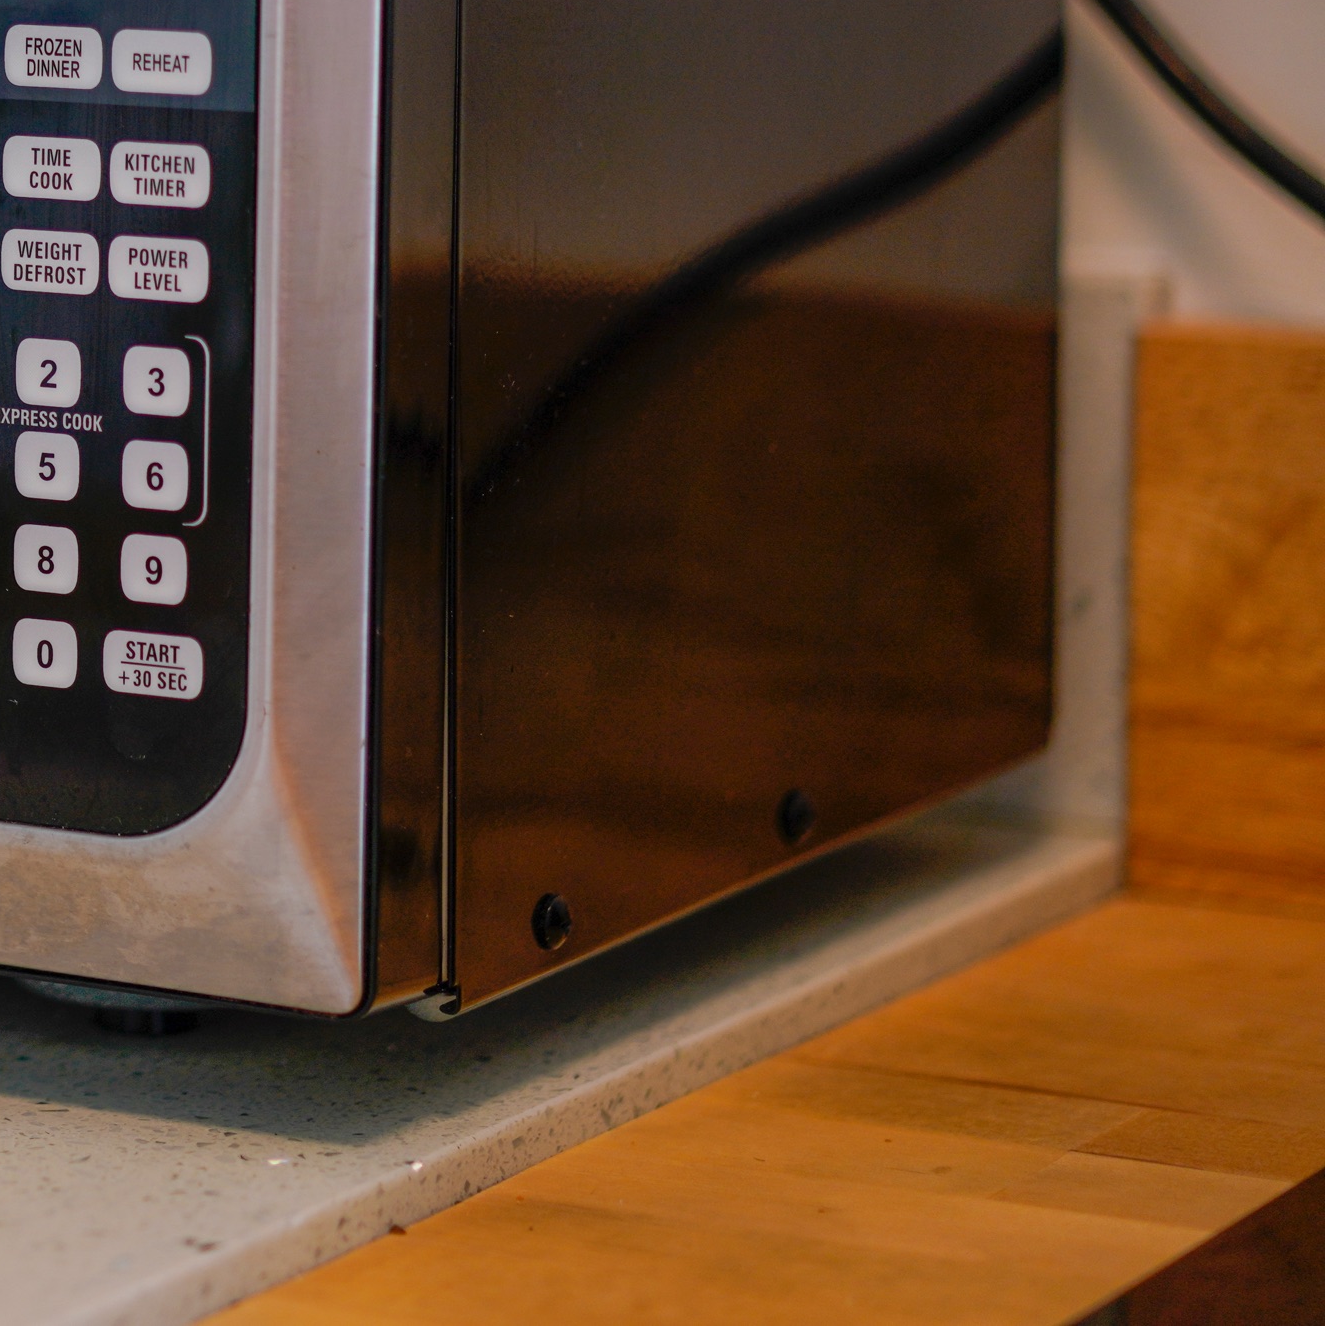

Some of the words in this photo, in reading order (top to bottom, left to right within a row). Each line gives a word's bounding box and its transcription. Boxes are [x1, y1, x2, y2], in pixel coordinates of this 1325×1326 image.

[25, 37, 82, 57] FROZEN
[26, 58, 80, 79] DINNER
[132, 52, 190, 73] REHEAT
[31, 147, 71, 167] TIME
[124, 153, 195, 175] KITCHEN
[29, 170, 73, 191] COOK
[133, 177, 185, 198] TIMER
[17, 240, 82, 262] WEIGHT
[128, 247, 188, 269] POWER
[13, 263, 87, 286] DEFROST
[134, 271, 182, 293] LEVEL
[39, 359, 58, 389] 2
[147, 367, 165, 397] 3
[62, 412, 103, 433] COOK
[38, 452, 56, 482] 5
[146, 461, 164, 491] 6
[37, 545, 55, 575] 8
[145, 555, 163, 585] 9
[36, 639, 54, 669] 0
[125, 640, 180, 664] START
[157, 671, 187, 692] SEC
